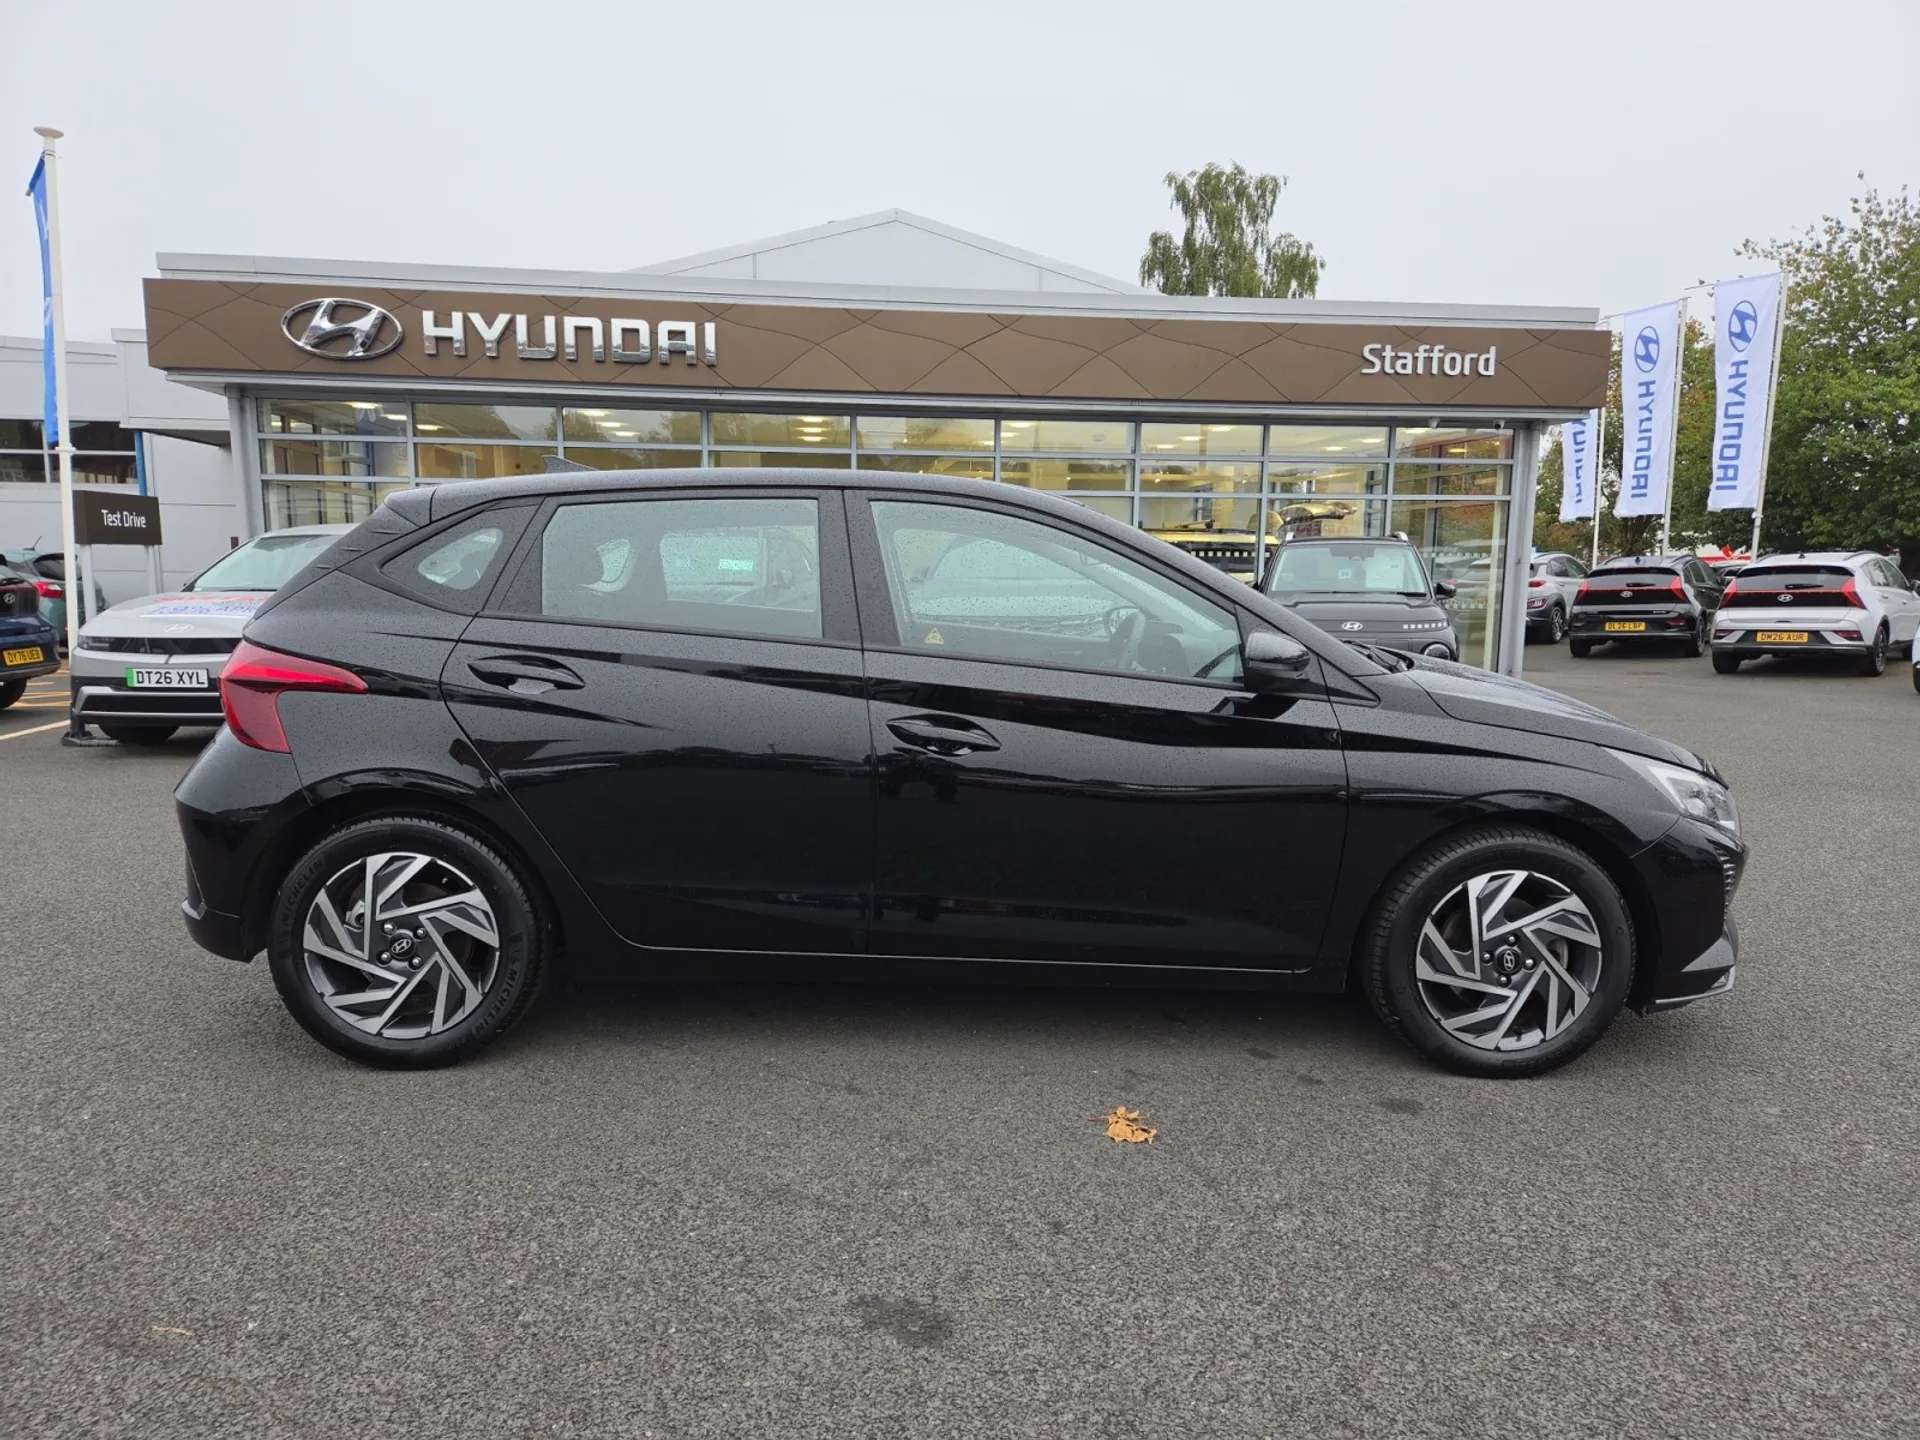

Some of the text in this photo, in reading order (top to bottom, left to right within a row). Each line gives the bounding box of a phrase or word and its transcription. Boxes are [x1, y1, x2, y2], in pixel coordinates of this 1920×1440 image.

[422, 309, 717, 367] HYUNDAI
[1361, 343, 1497, 376] Stafford
[1630, 379, 1656, 498] HYUNDAI
[1715, 359, 1749, 491] HYUNDAI
[101, 508, 147, 528] Test Drive
[135, 671, 206, 685] DT26 XYL
[474, 967, 518, 1037] MICHELIN
